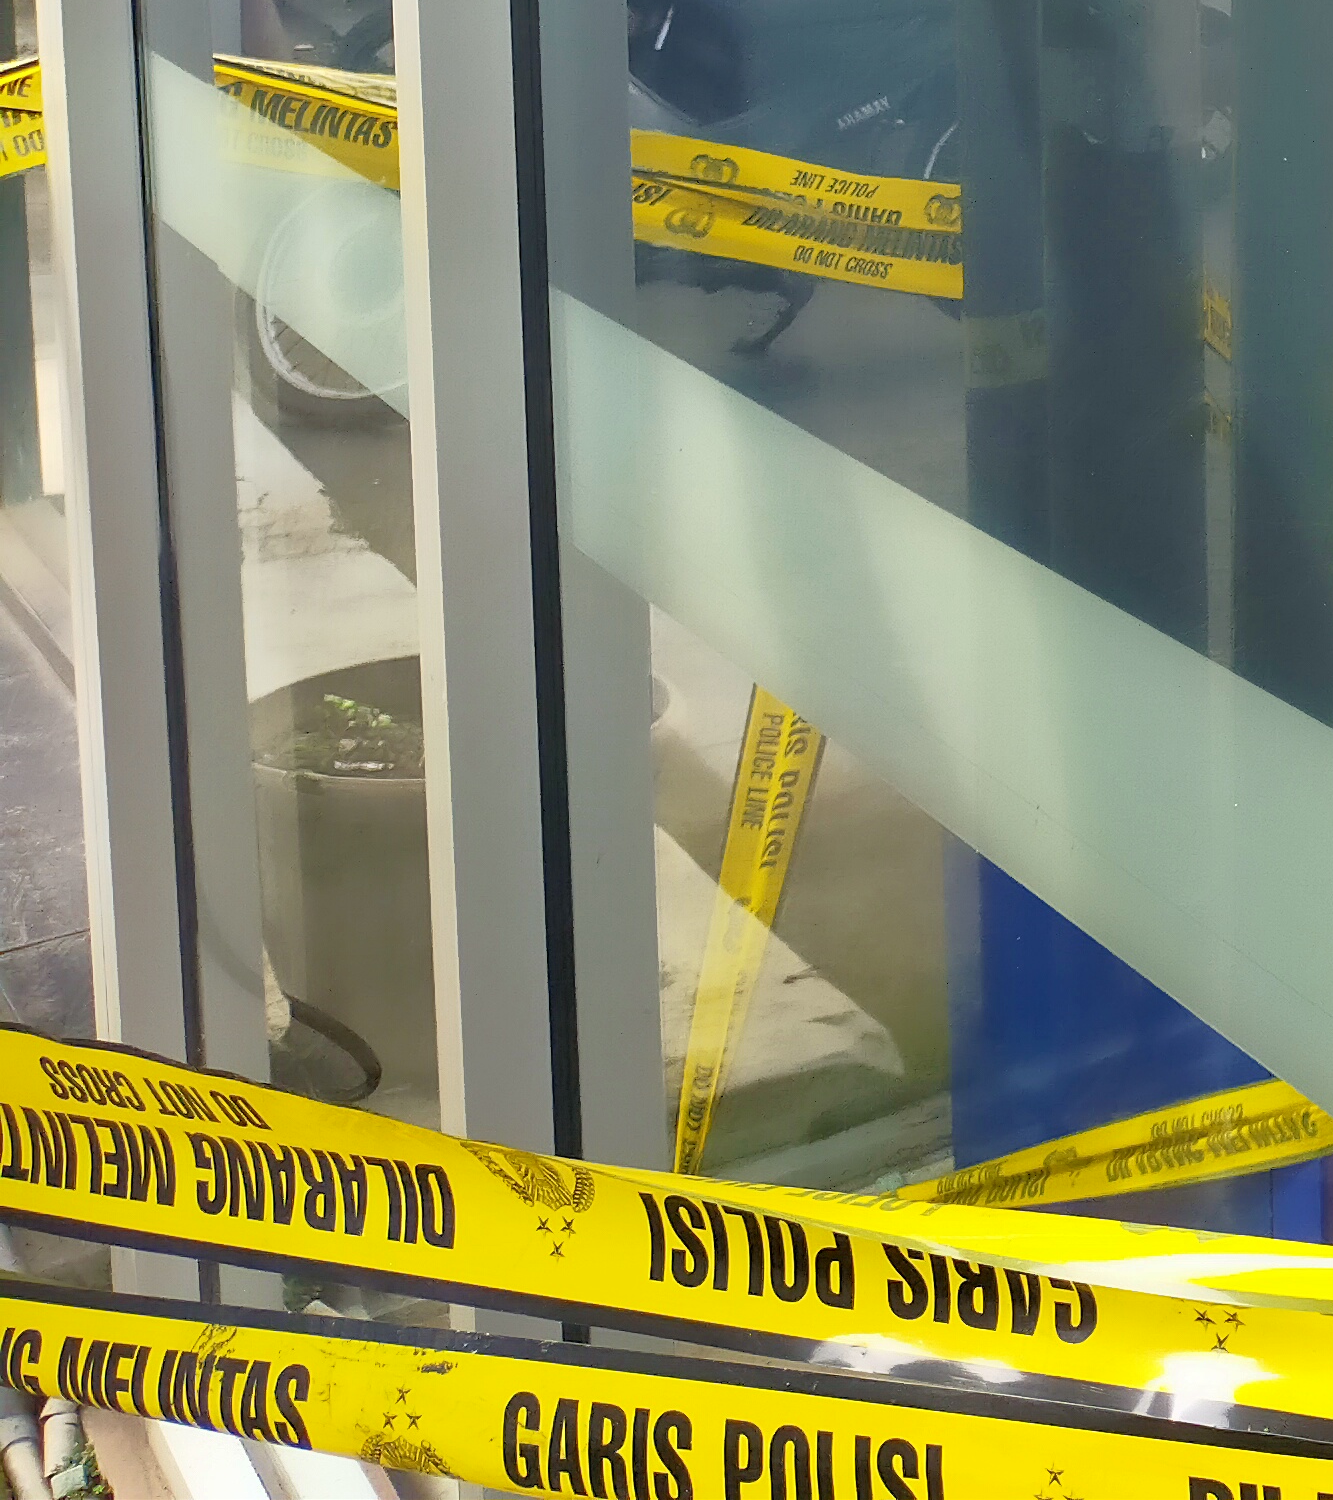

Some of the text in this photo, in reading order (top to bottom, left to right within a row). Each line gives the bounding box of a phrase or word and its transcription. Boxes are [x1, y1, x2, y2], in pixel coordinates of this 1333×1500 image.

[790, 169, 881, 199] POLICE LINE
[792, 245, 893, 279] DO NOT CROSS
[740, 711, 785, 831] POLICE LINE
[40, 1056, 272, 1130] DO NOT CROSS
[0, 1104, 456, 1249] DILARANG MELINT
[639, 1192, 1097, 1344] GARIS POLISI
[57, 1336, 311, 1450] MELINTAS
[502, 1392, 693, 1500] GARIS
